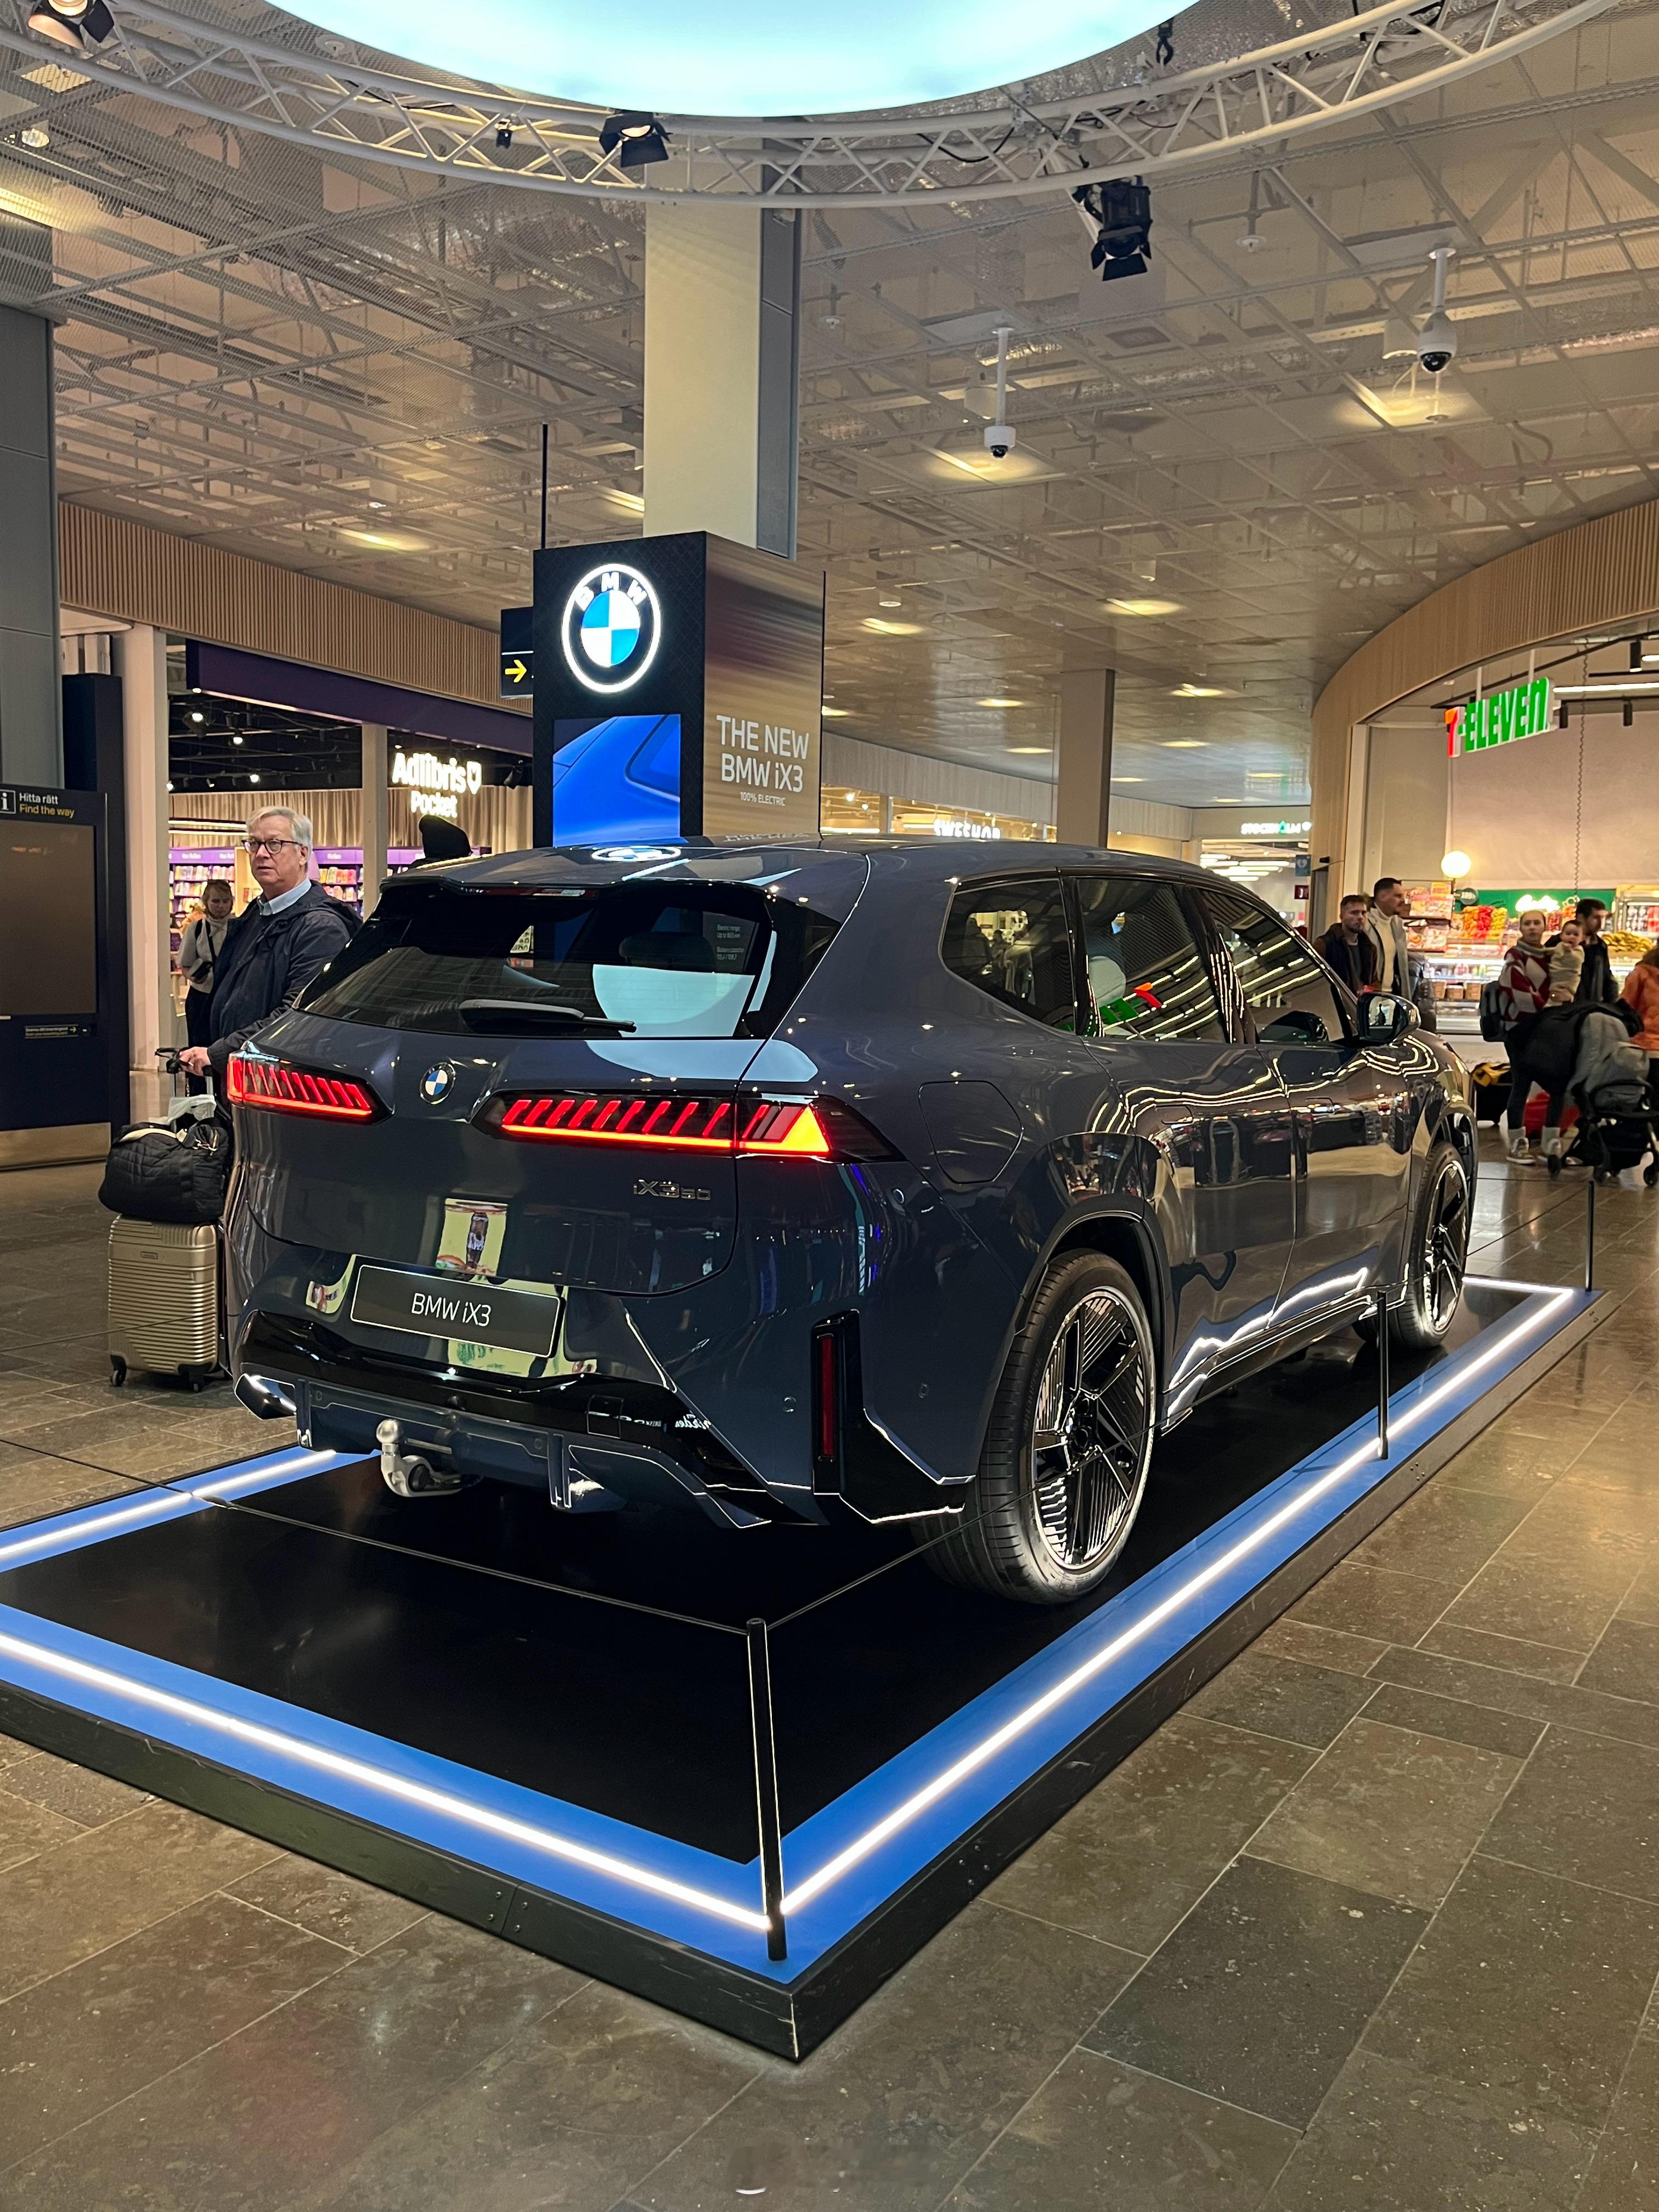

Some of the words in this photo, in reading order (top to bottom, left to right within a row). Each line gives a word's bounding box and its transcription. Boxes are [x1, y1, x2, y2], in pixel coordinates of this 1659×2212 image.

[574, 571, 648, 611] BMW
[716, 715, 759, 751] THE
[765, 725, 809, 759] NEW
[392, 752, 467, 793] Adlibris
[721, 753, 770, 787] BMW
[775, 762, 803, 792] iX3
[19, 792, 41, 803] Hitta
[42, 794, 59, 805] rätt
[19, 804, 39, 814] Find
[41, 805, 55, 815] the
[57, 809, 75, 819] way
[411, 790, 458, 818] Pocket
[740, 792, 757, 803] 100%
[758, 794, 786, 806] ELECTRIC
[411, 1293, 460, 1321] BMW
[462, 1302, 492, 1327] iX3
